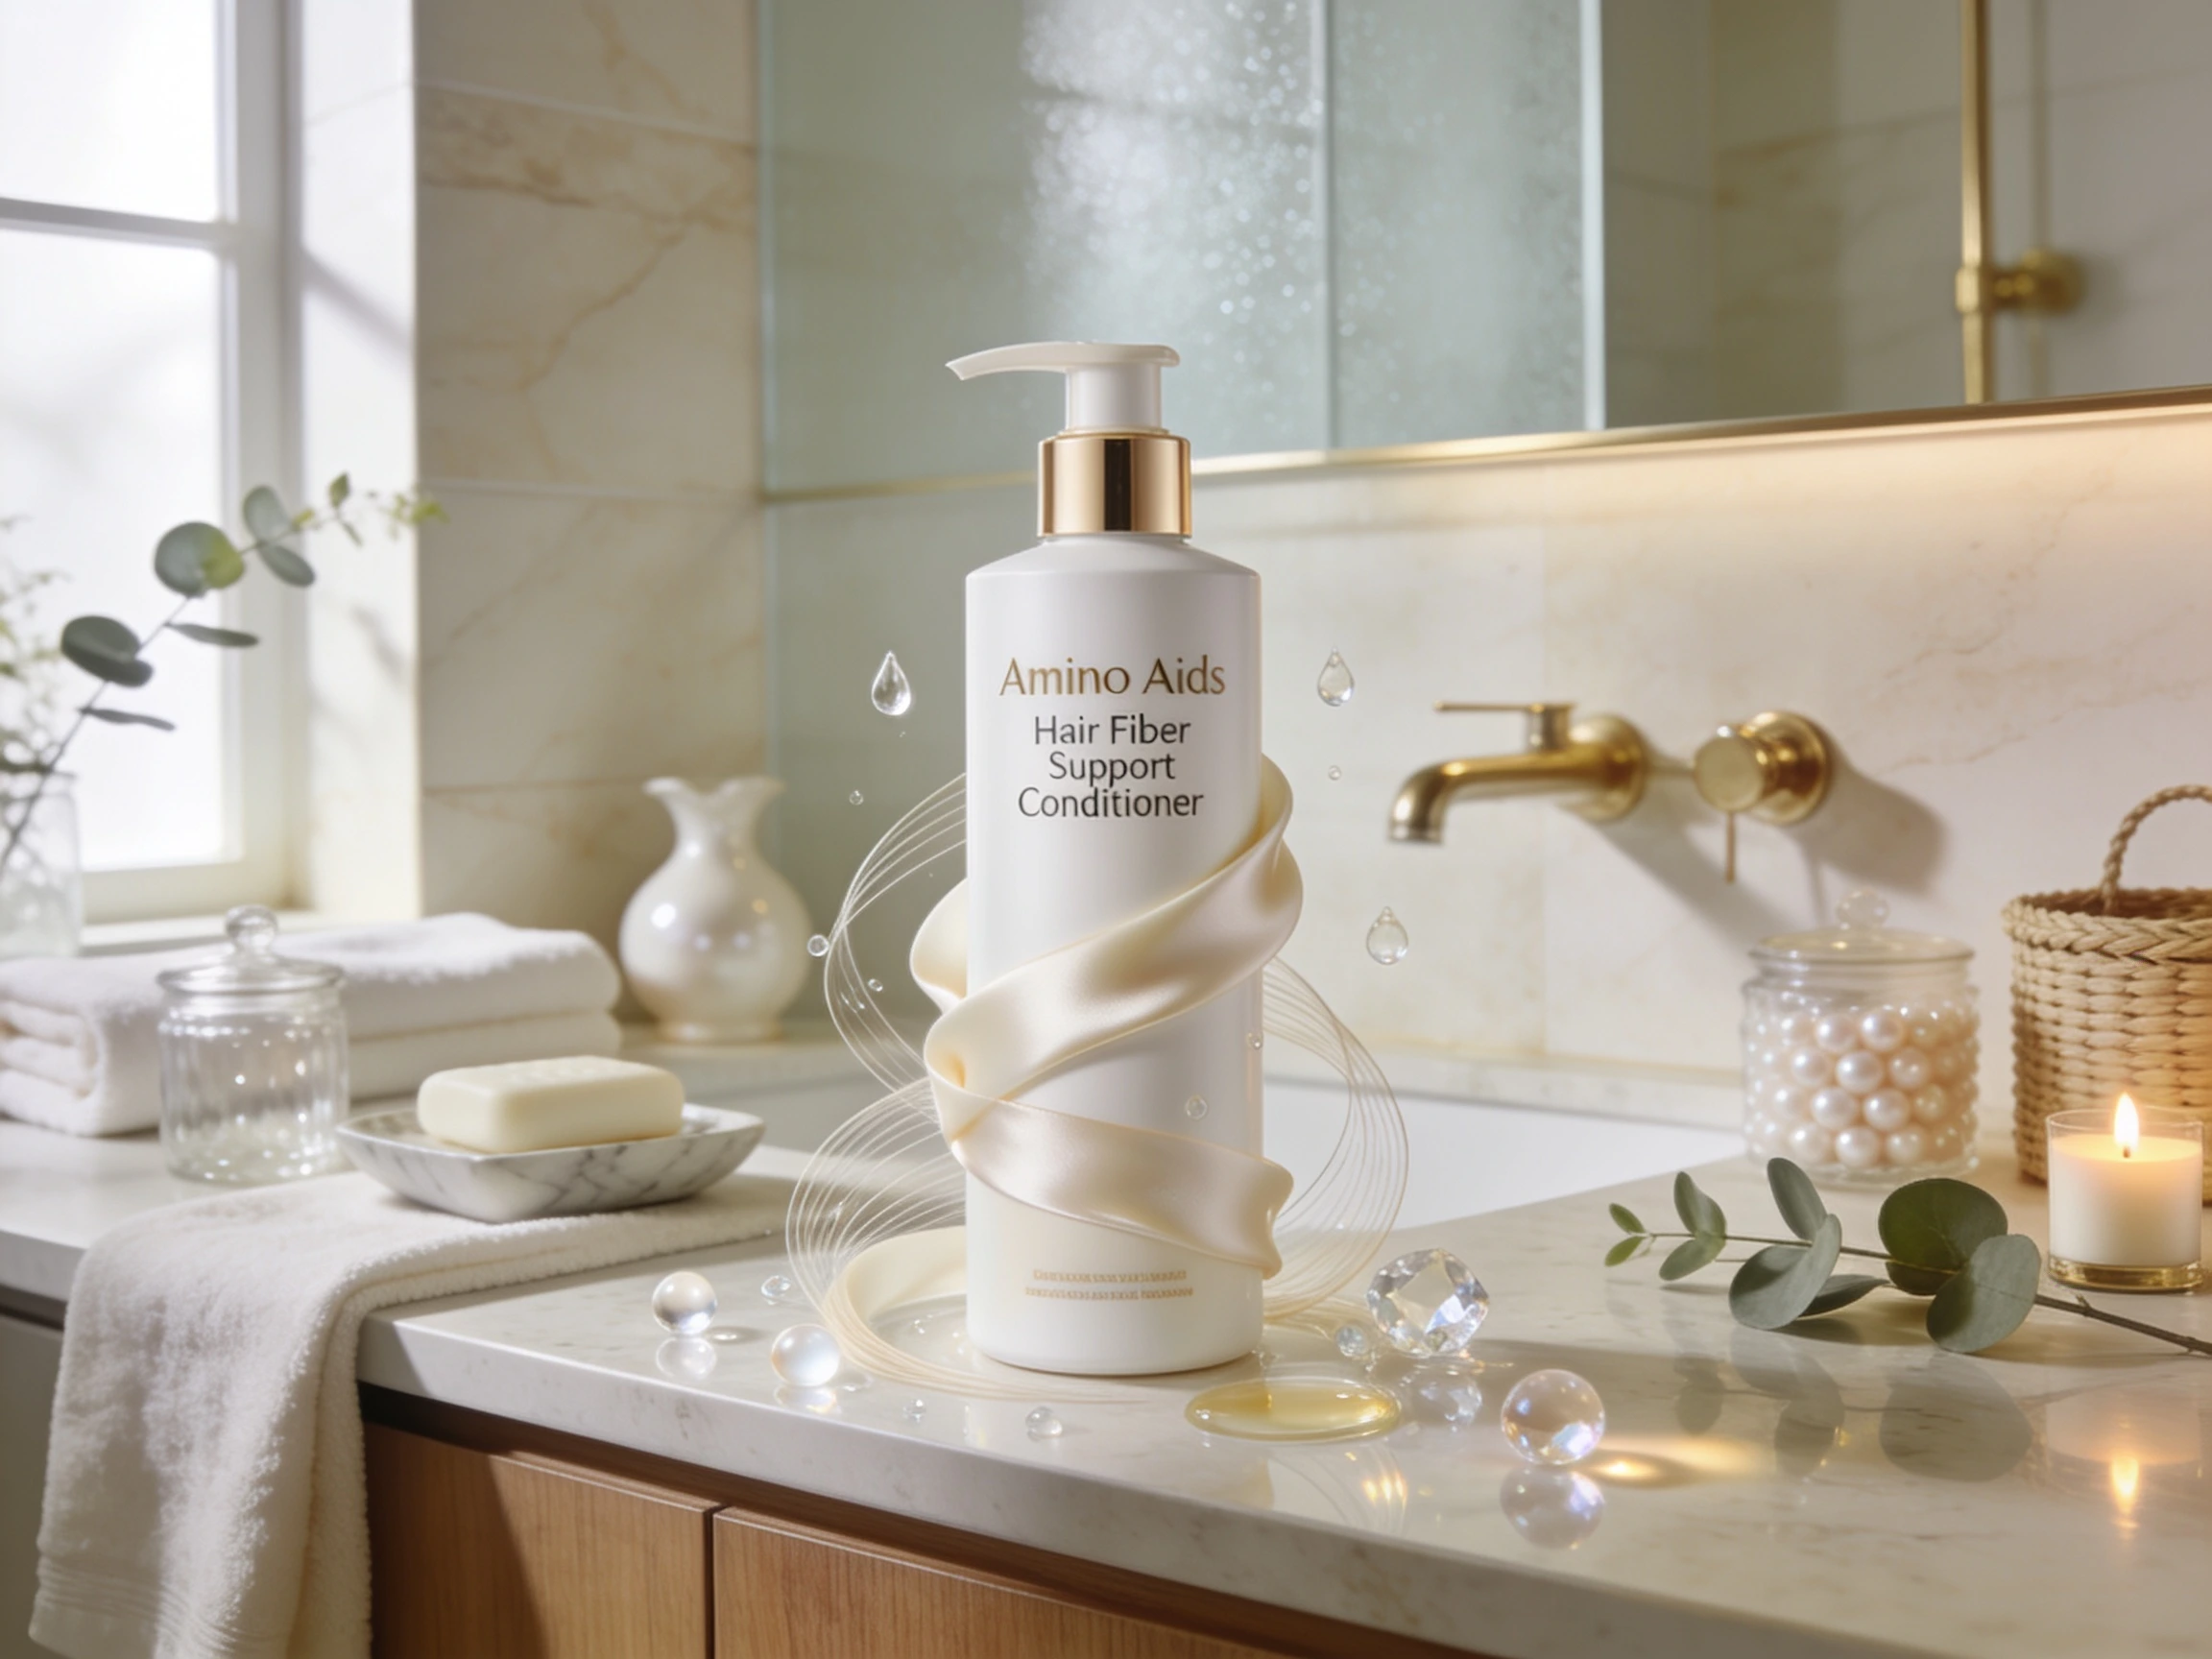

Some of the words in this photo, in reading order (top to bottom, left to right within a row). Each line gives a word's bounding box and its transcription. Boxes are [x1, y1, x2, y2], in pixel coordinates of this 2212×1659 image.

[999, 657, 1131, 696] Amino
[1142, 655, 1226, 696] Aids
[1034, 715, 1100, 745] Hair
[1110, 713, 1191, 745] Fiber
[1048, 751, 1176, 788] Support
[1018, 787, 1205, 818] Conditioner
